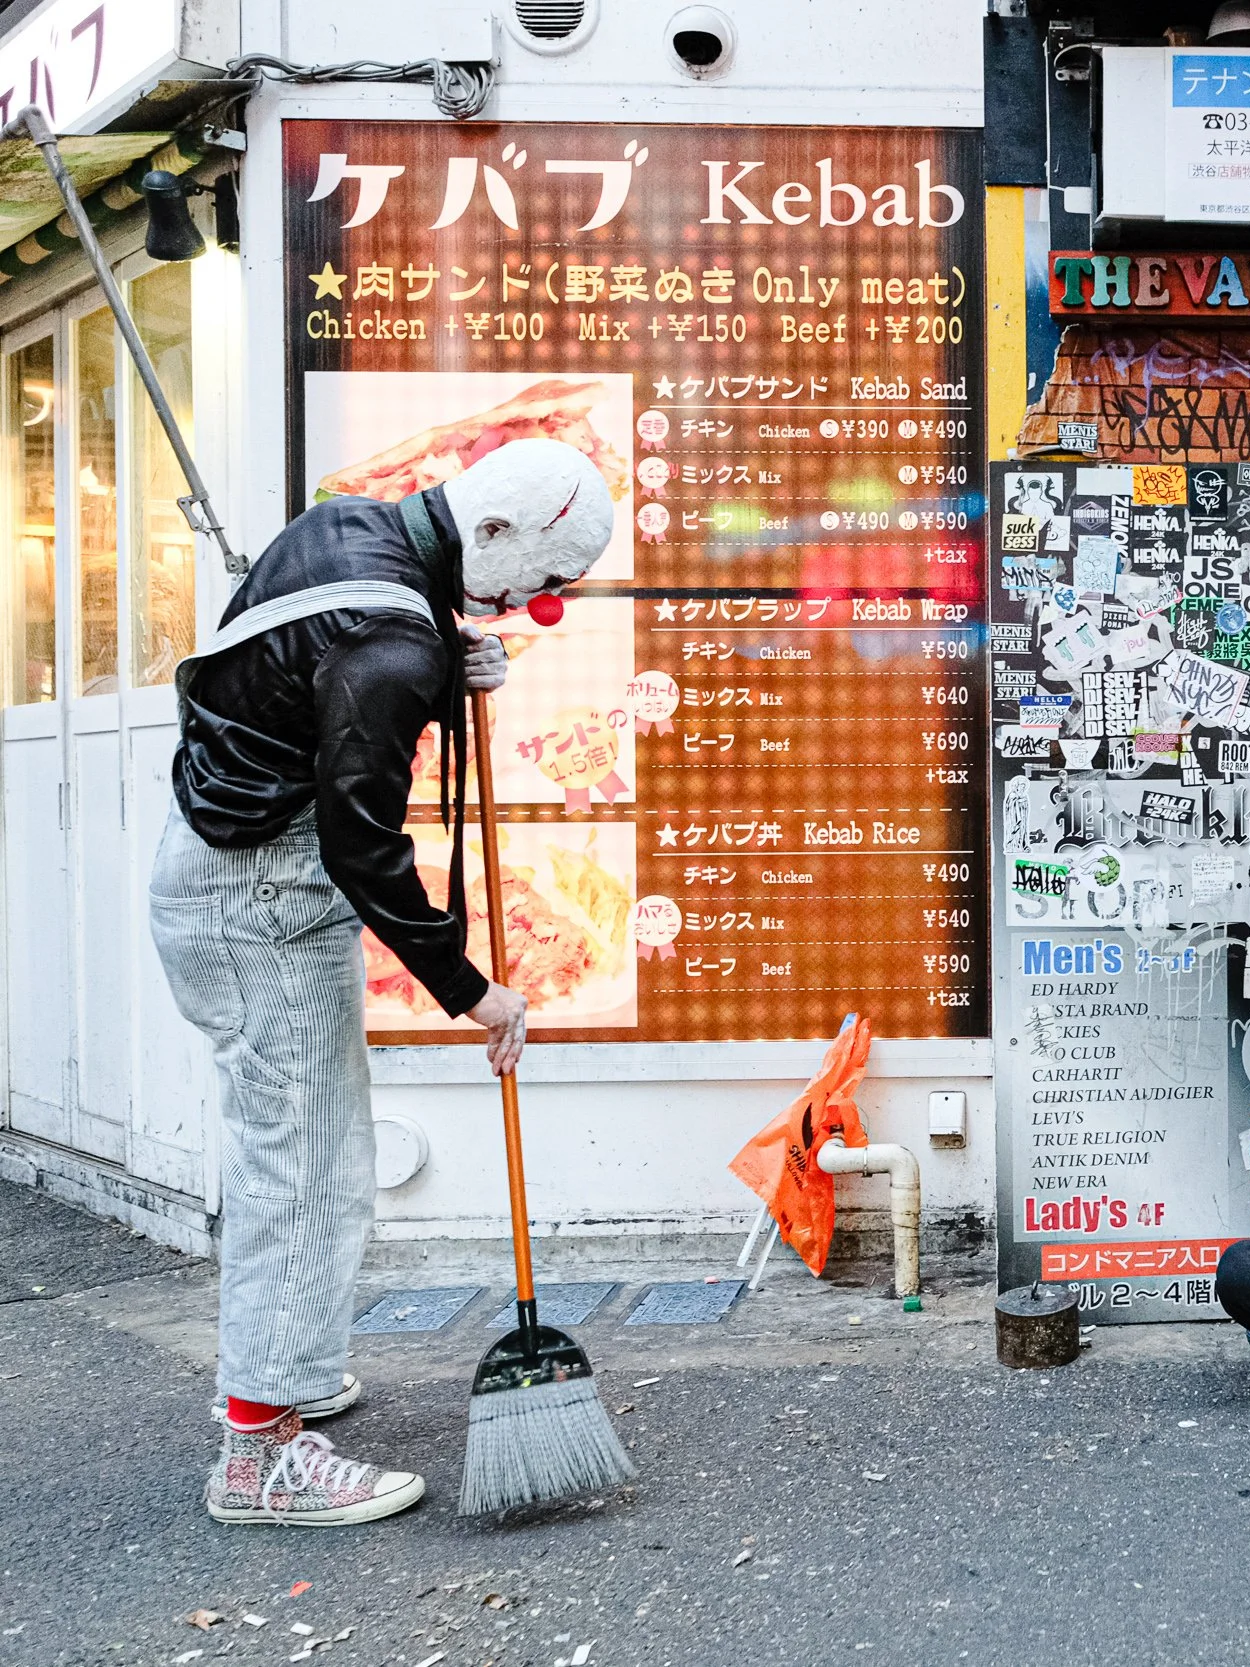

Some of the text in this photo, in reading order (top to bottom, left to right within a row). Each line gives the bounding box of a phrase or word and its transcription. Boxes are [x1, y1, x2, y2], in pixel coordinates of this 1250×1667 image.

[307, 139, 965, 231] ケバブ Kebab
[753, 267, 835, 310] Only
[862, 266, 967, 306] meat)
[1054, 256, 1169, 307] THE
[307, 310, 427, 343] Chicken
[579, 315, 630, 343] Mix
[780, 315, 846, 344] Beef
[679, 376, 967, 401] ケバブサンド Kebab Sand
[681, 418, 967, 439] チキン Chicken ¥390 ¥490
[1059, 424, 1098, 437] MENIS
[1061, 438, 1094, 451] STAR!
[681, 465, 752, 487] ミックス
[758, 470, 781, 485] Mix
[921, 464, 967, 485] ¥540
[759, 515, 789, 530] Beef
[842, 510, 889, 531] ¥490
[921, 510, 967, 531] ¥590
[1006, 518, 1035, 534] suck
[1005, 536, 1035, 549] sess
[924, 546, 967, 564] +tax
[1191, 558, 1234, 580] JS
[1184, 583, 1241, 599] ONE
[682, 596, 968, 623] ケバブラップ Kebab Wrap
[991, 627, 1032, 638] MENIS
[682, 641, 968, 661] チキン Chicken ¥590
[993, 640, 1029, 652] STAR!
[994, 673, 1036, 685] MENIS
[683, 686, 968, 707] ミックス Mix ¥640
[760, 738, 790, 752] Beef
[922, 731, 969, 751] ¥690
[926, 768, 969, 785] +tax
[1144, 793, 1192, 809] HALO
[683, 822, 920, 847] ケバブ丼 Kebab Rice
[684, 863, 969, 885] チキン Chicken ¥490
[685, 909, 969, 931] ミックス Mix ¥540
[762, 962, 792, 976] Beef
[923, 954, 970, 974] ¥590
[1023, 940, 1123, 975] Men's
[927, 990, 970, 1007] +tax
[1031, 981, 1119, 997] ED HARDY
[1091, 1002, 1149, 1017] BRAND
[1071, 1046, 1116, 1060] CLUB
[1032, 1067, 1122, 1083] CARHARTT
[1032, 1086, 1215, 1104] CHRISTIAN AUDIGIER
[1032, 1111, 1084, 1127] LEVI'S
[1033, 1129, 1167, 1148] TRUE RELIGION
[1032, 1151, 1149, 1169] ANTIK DENIM
[1032, 1174, 1107, 1190] NEW ERA
[1025, 1196, 1128, 1233] Lady's
[1047, 1245, 1221, 1275] コンドマニア入口
